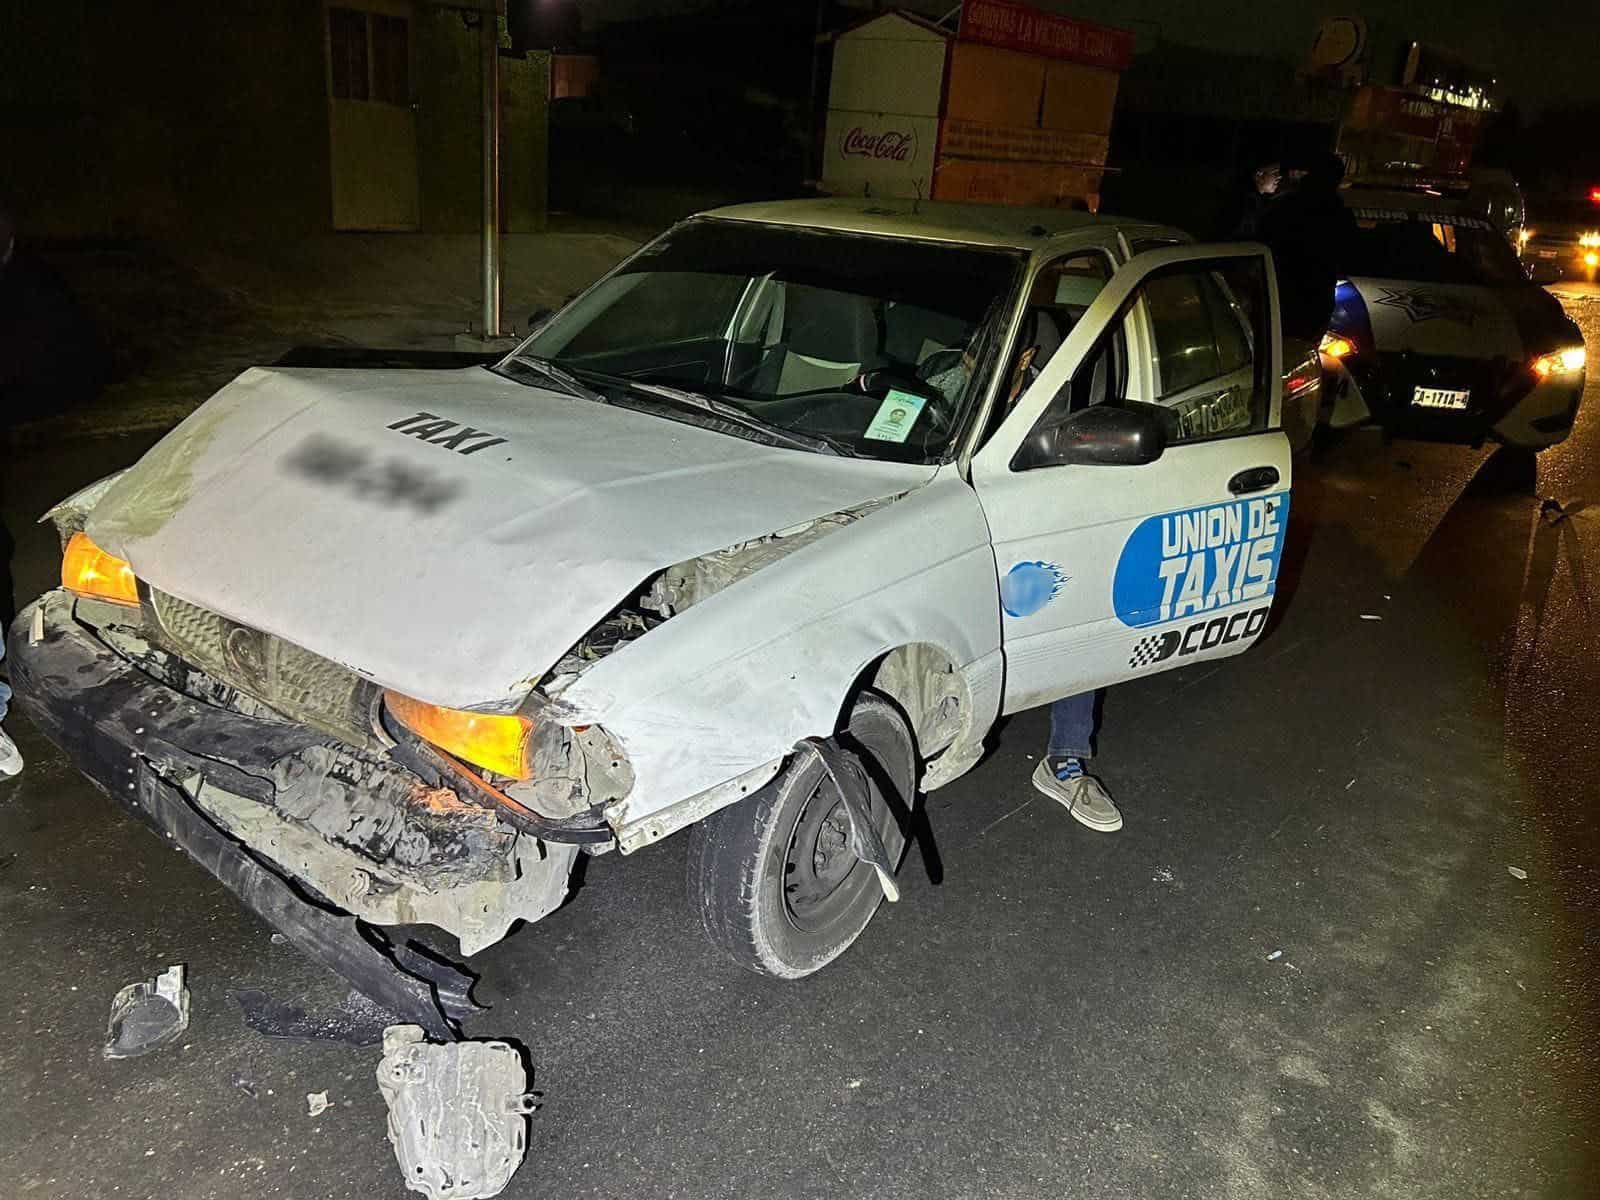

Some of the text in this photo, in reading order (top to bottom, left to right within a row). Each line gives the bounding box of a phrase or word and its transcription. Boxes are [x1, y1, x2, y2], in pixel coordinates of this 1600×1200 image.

[387, 411, 508, 455] TAXI
[1161, 495, 1281, 558] UNION DE
[1158, 535, 1277, 622] TAXIS
